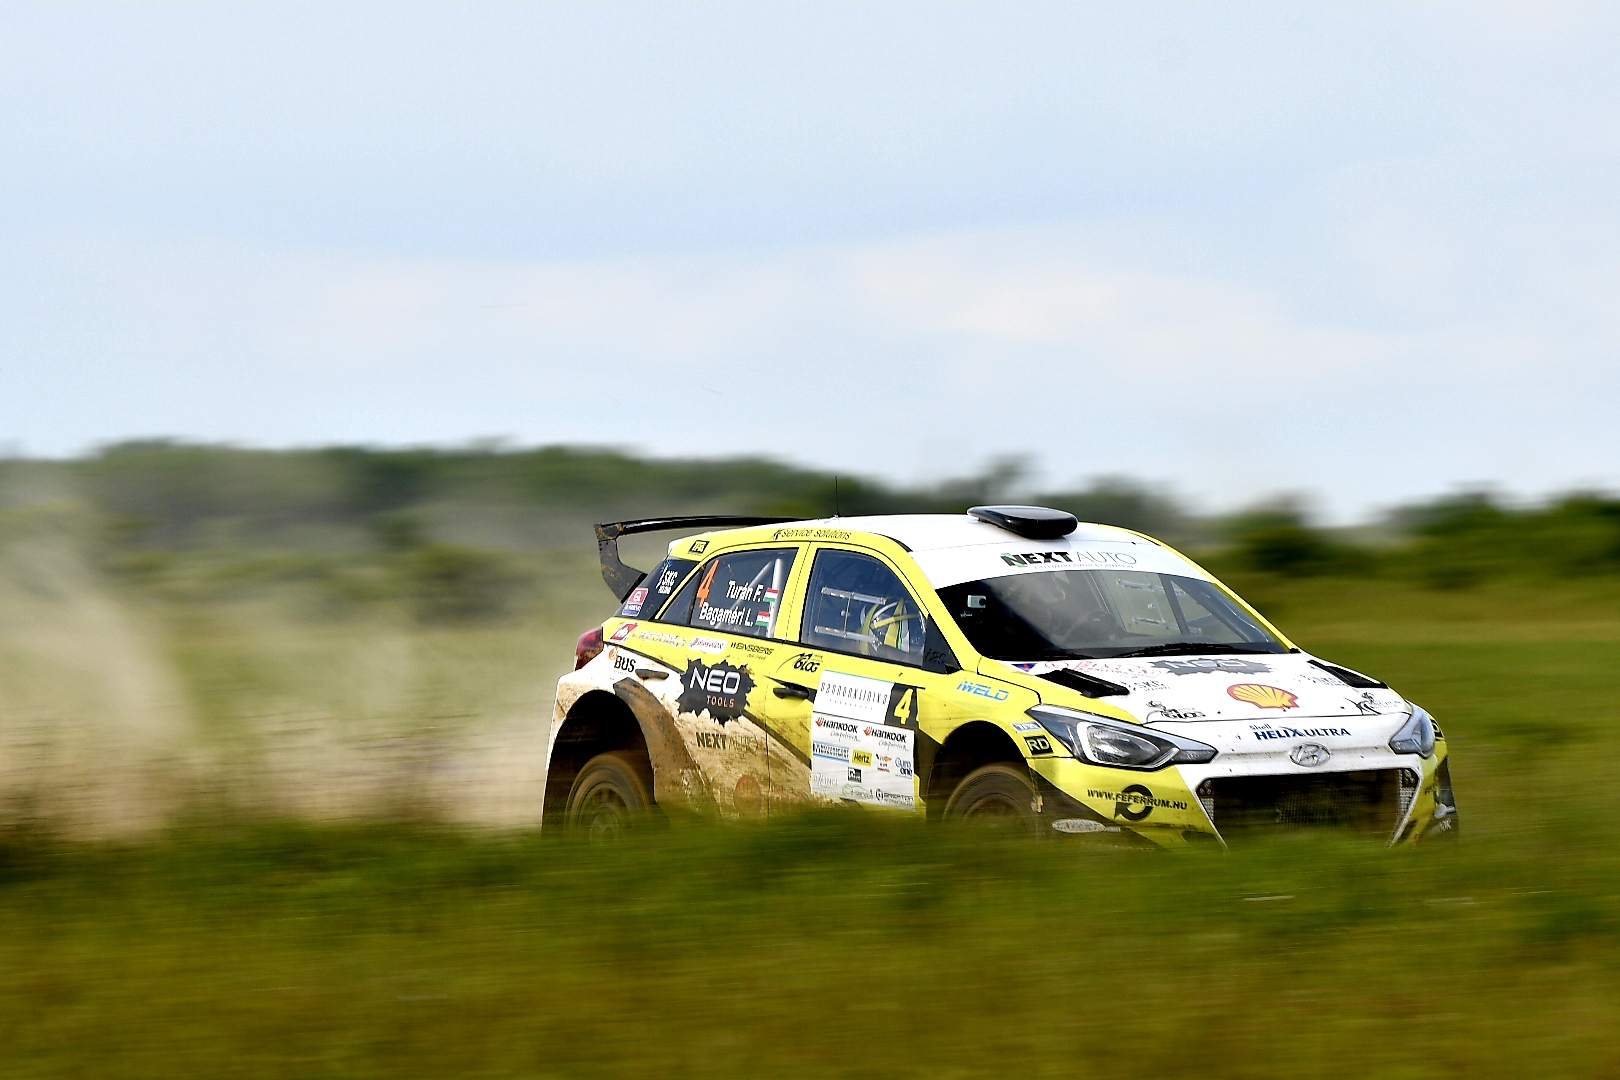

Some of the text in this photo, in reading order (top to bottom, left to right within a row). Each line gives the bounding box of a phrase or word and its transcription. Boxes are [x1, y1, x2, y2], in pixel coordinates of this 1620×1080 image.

[782, 529, 851, 541] service solutions
[1000, 551, 1073, 568] NEXT
[1076, 551, 1137, 564] AUTO
[697, 559, 719, 608] 4
[726, 580, 764, 602] Turán F.
[699, 601, 754, 627] Bagaméri L.
[613, 655, 636, 673] BUS
[689, 666, 741, 695] NEO
[706, 695, 735, 709] TOOLS
[893, 688, 914, 725] 4
[695, 732, 727, 750] NEXT
[1253, 727, 1351, 741] HELIX ULTRA
[1026, 738, 1050, 751] RD
[853, 752, 870, 764] Hertz
[1087, 788, 1188, 810] WWW.FEFERRUM.HU
